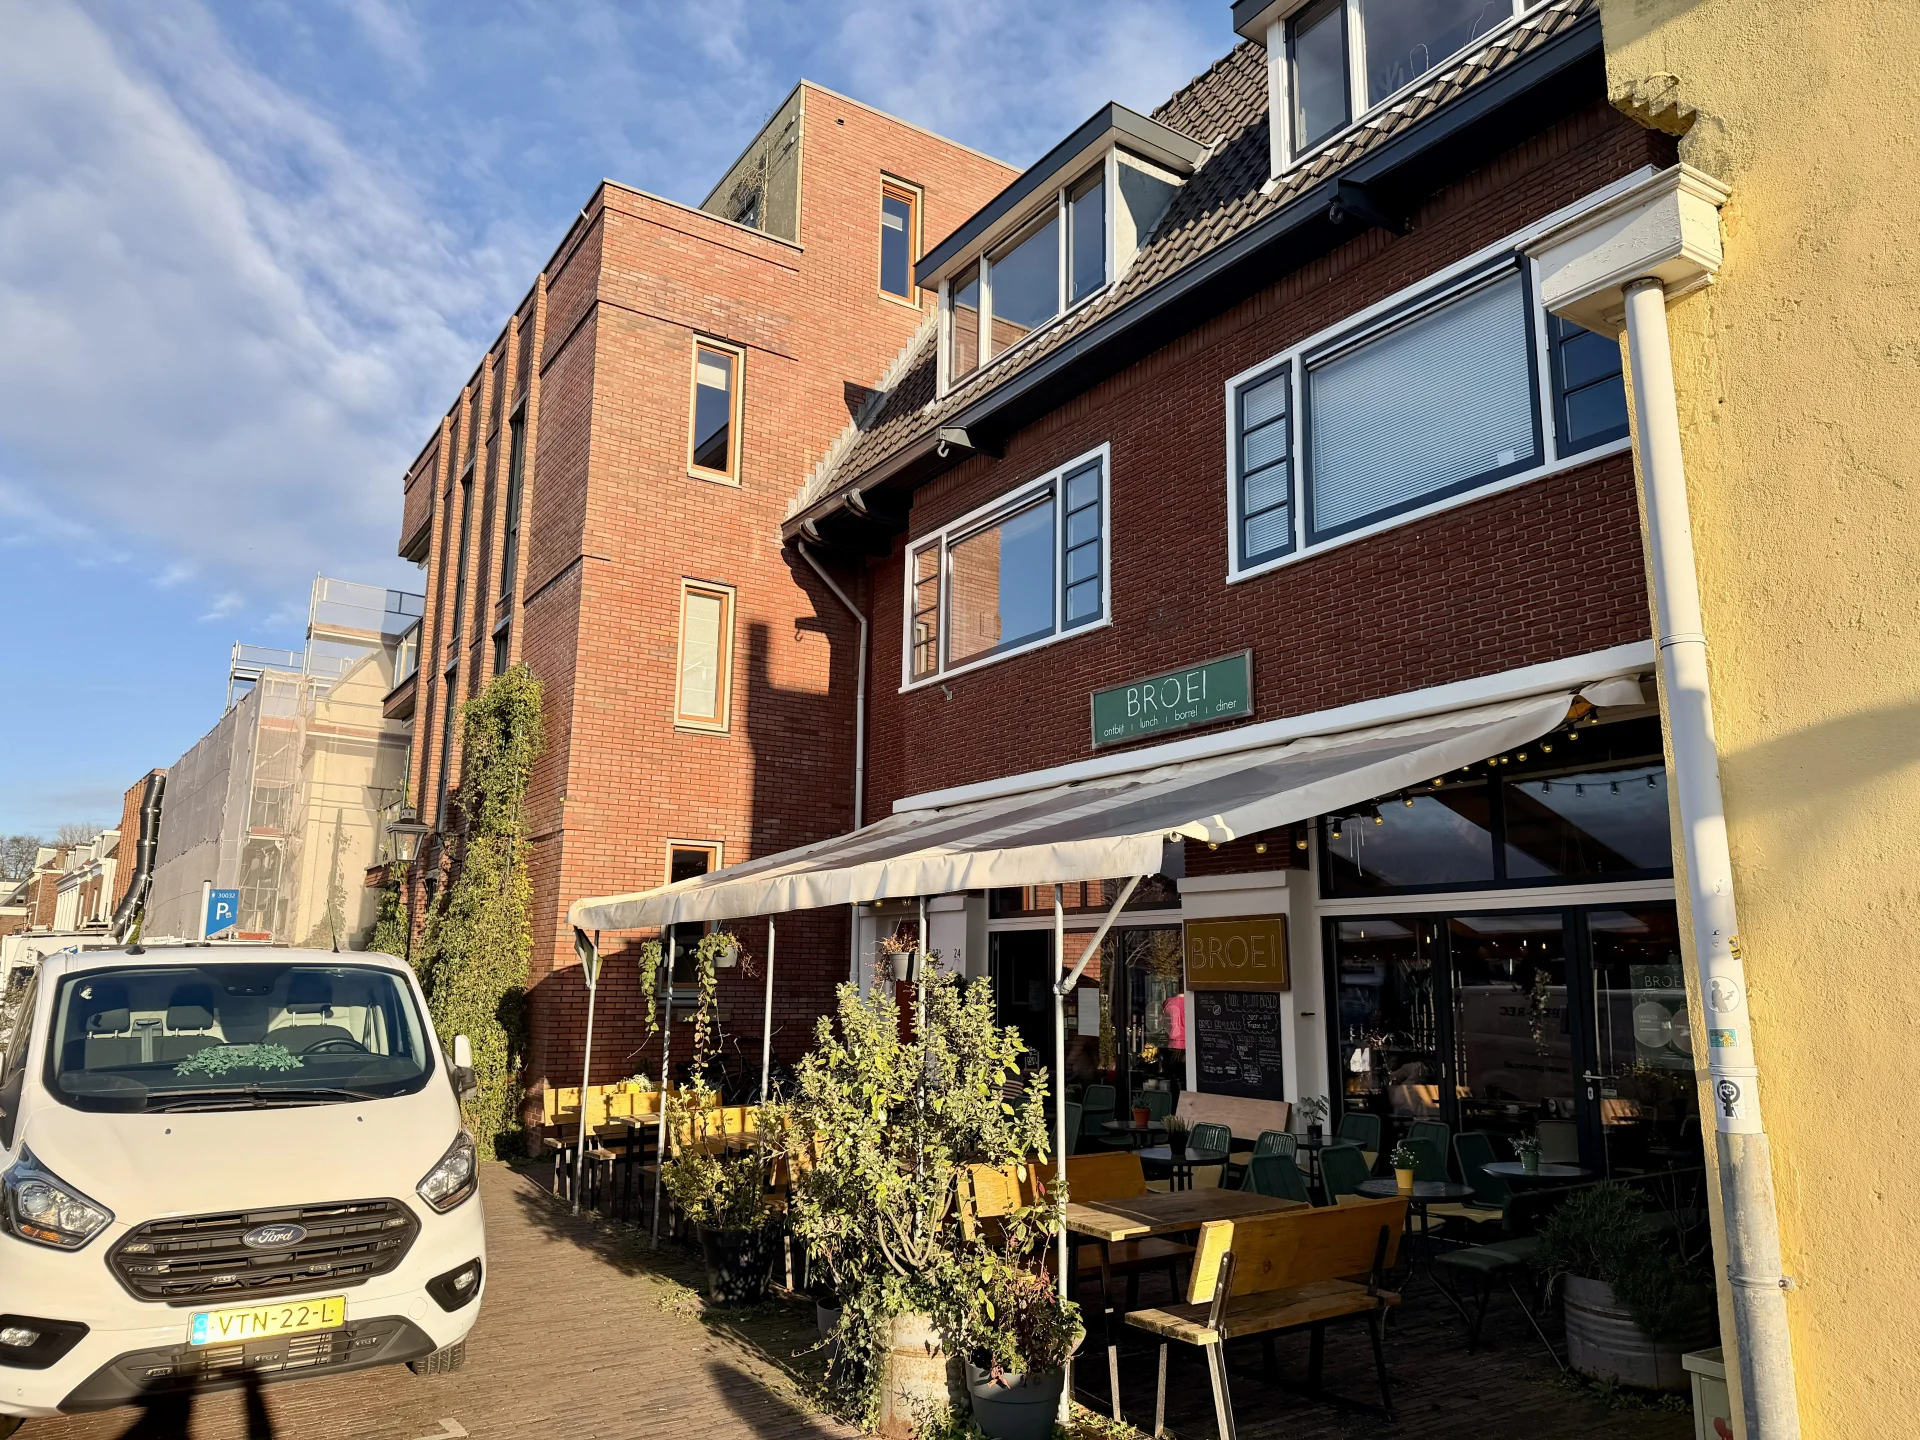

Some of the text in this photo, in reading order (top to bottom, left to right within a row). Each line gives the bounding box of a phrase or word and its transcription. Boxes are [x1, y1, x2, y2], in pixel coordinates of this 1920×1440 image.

[1127, 670, 1206, 717] BROEI
[1103, 699, 1237, 737] ontbijt lunch borrel diner
[216, 902, 229, 920] P
[953, 948, 961, 958] 24
[1191, 934, 1276, 969] BROEI
[1644, 975, 1682, 988] BROE
[257, 1226, 294, 1244] Ford
[219, 1303, 333, 1336] VTN-22-L
